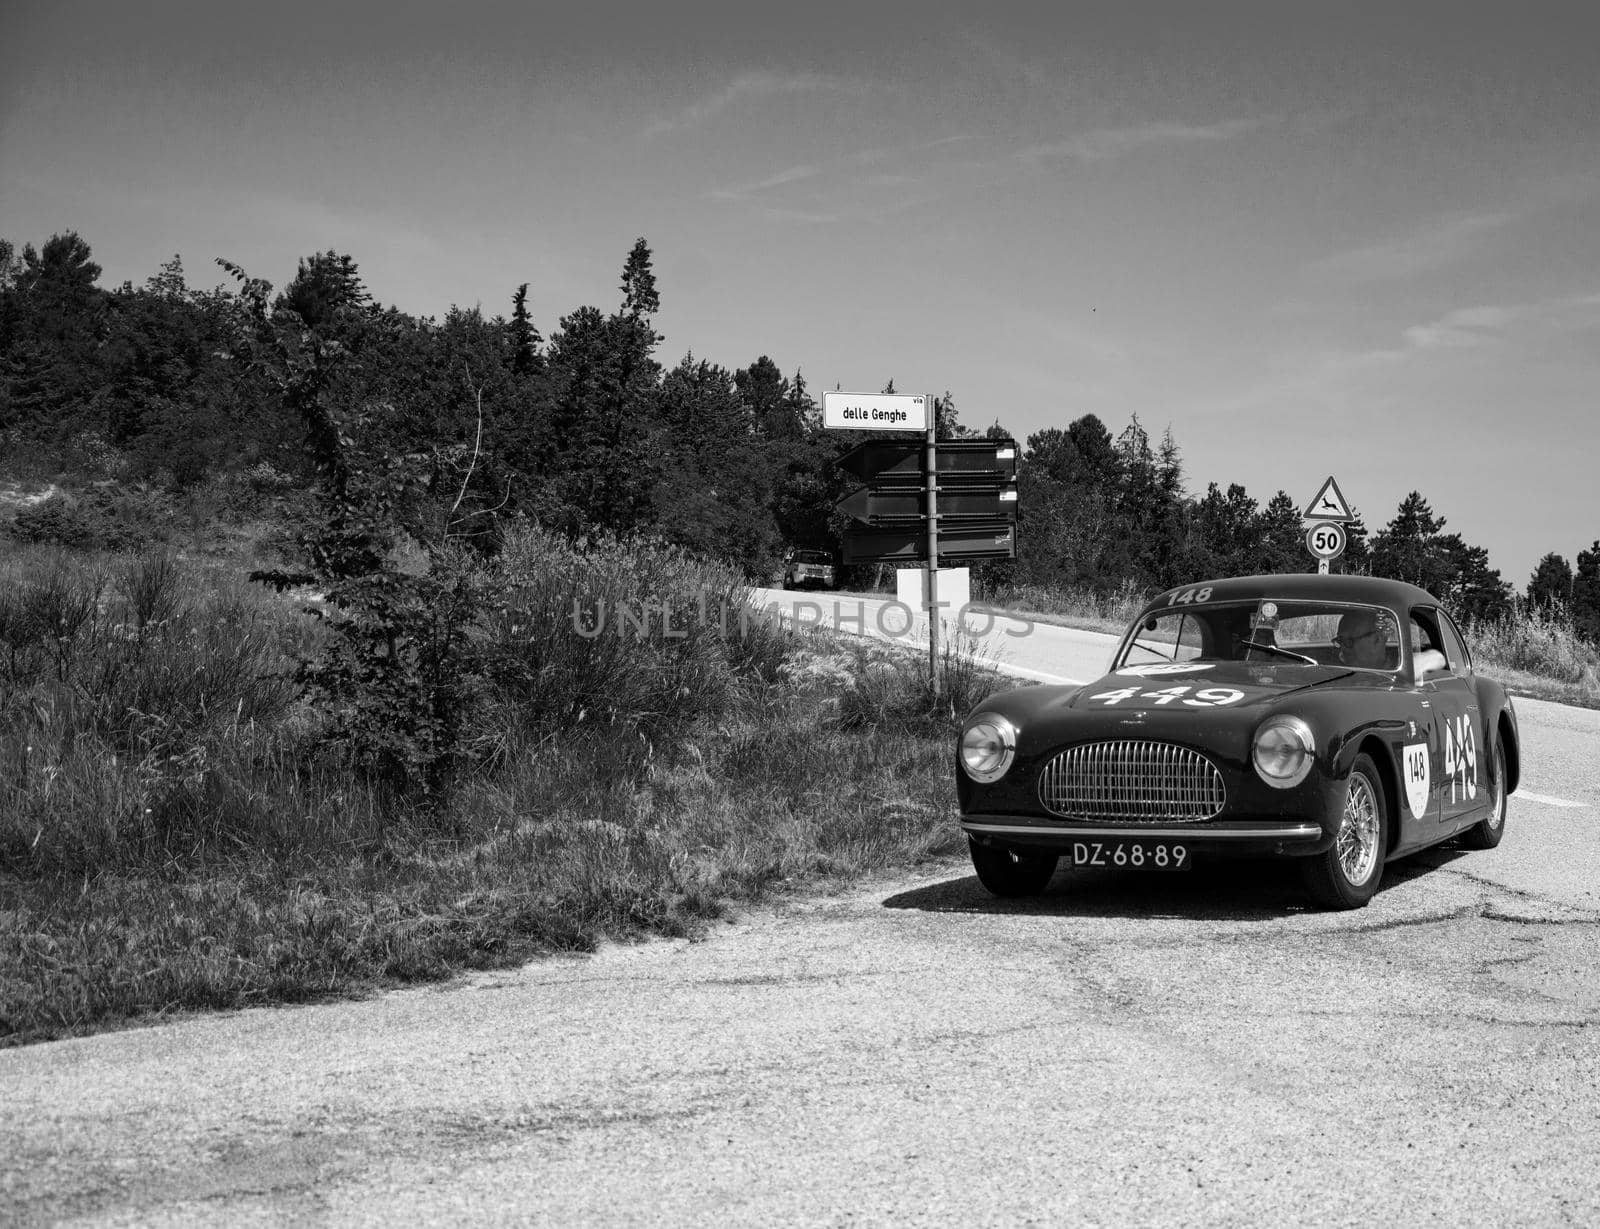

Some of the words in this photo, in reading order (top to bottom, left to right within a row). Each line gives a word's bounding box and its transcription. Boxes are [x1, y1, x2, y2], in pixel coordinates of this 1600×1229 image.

[843, 407, 869, 420] delle
[871, 408, 907, 423] Genghe
[1315, 532, 1338, 550] 50
[1167, 587, 1213, 606] 148
[1089, 686, 1245, 706] 449
[1408, 751, 1425, 783] 148
